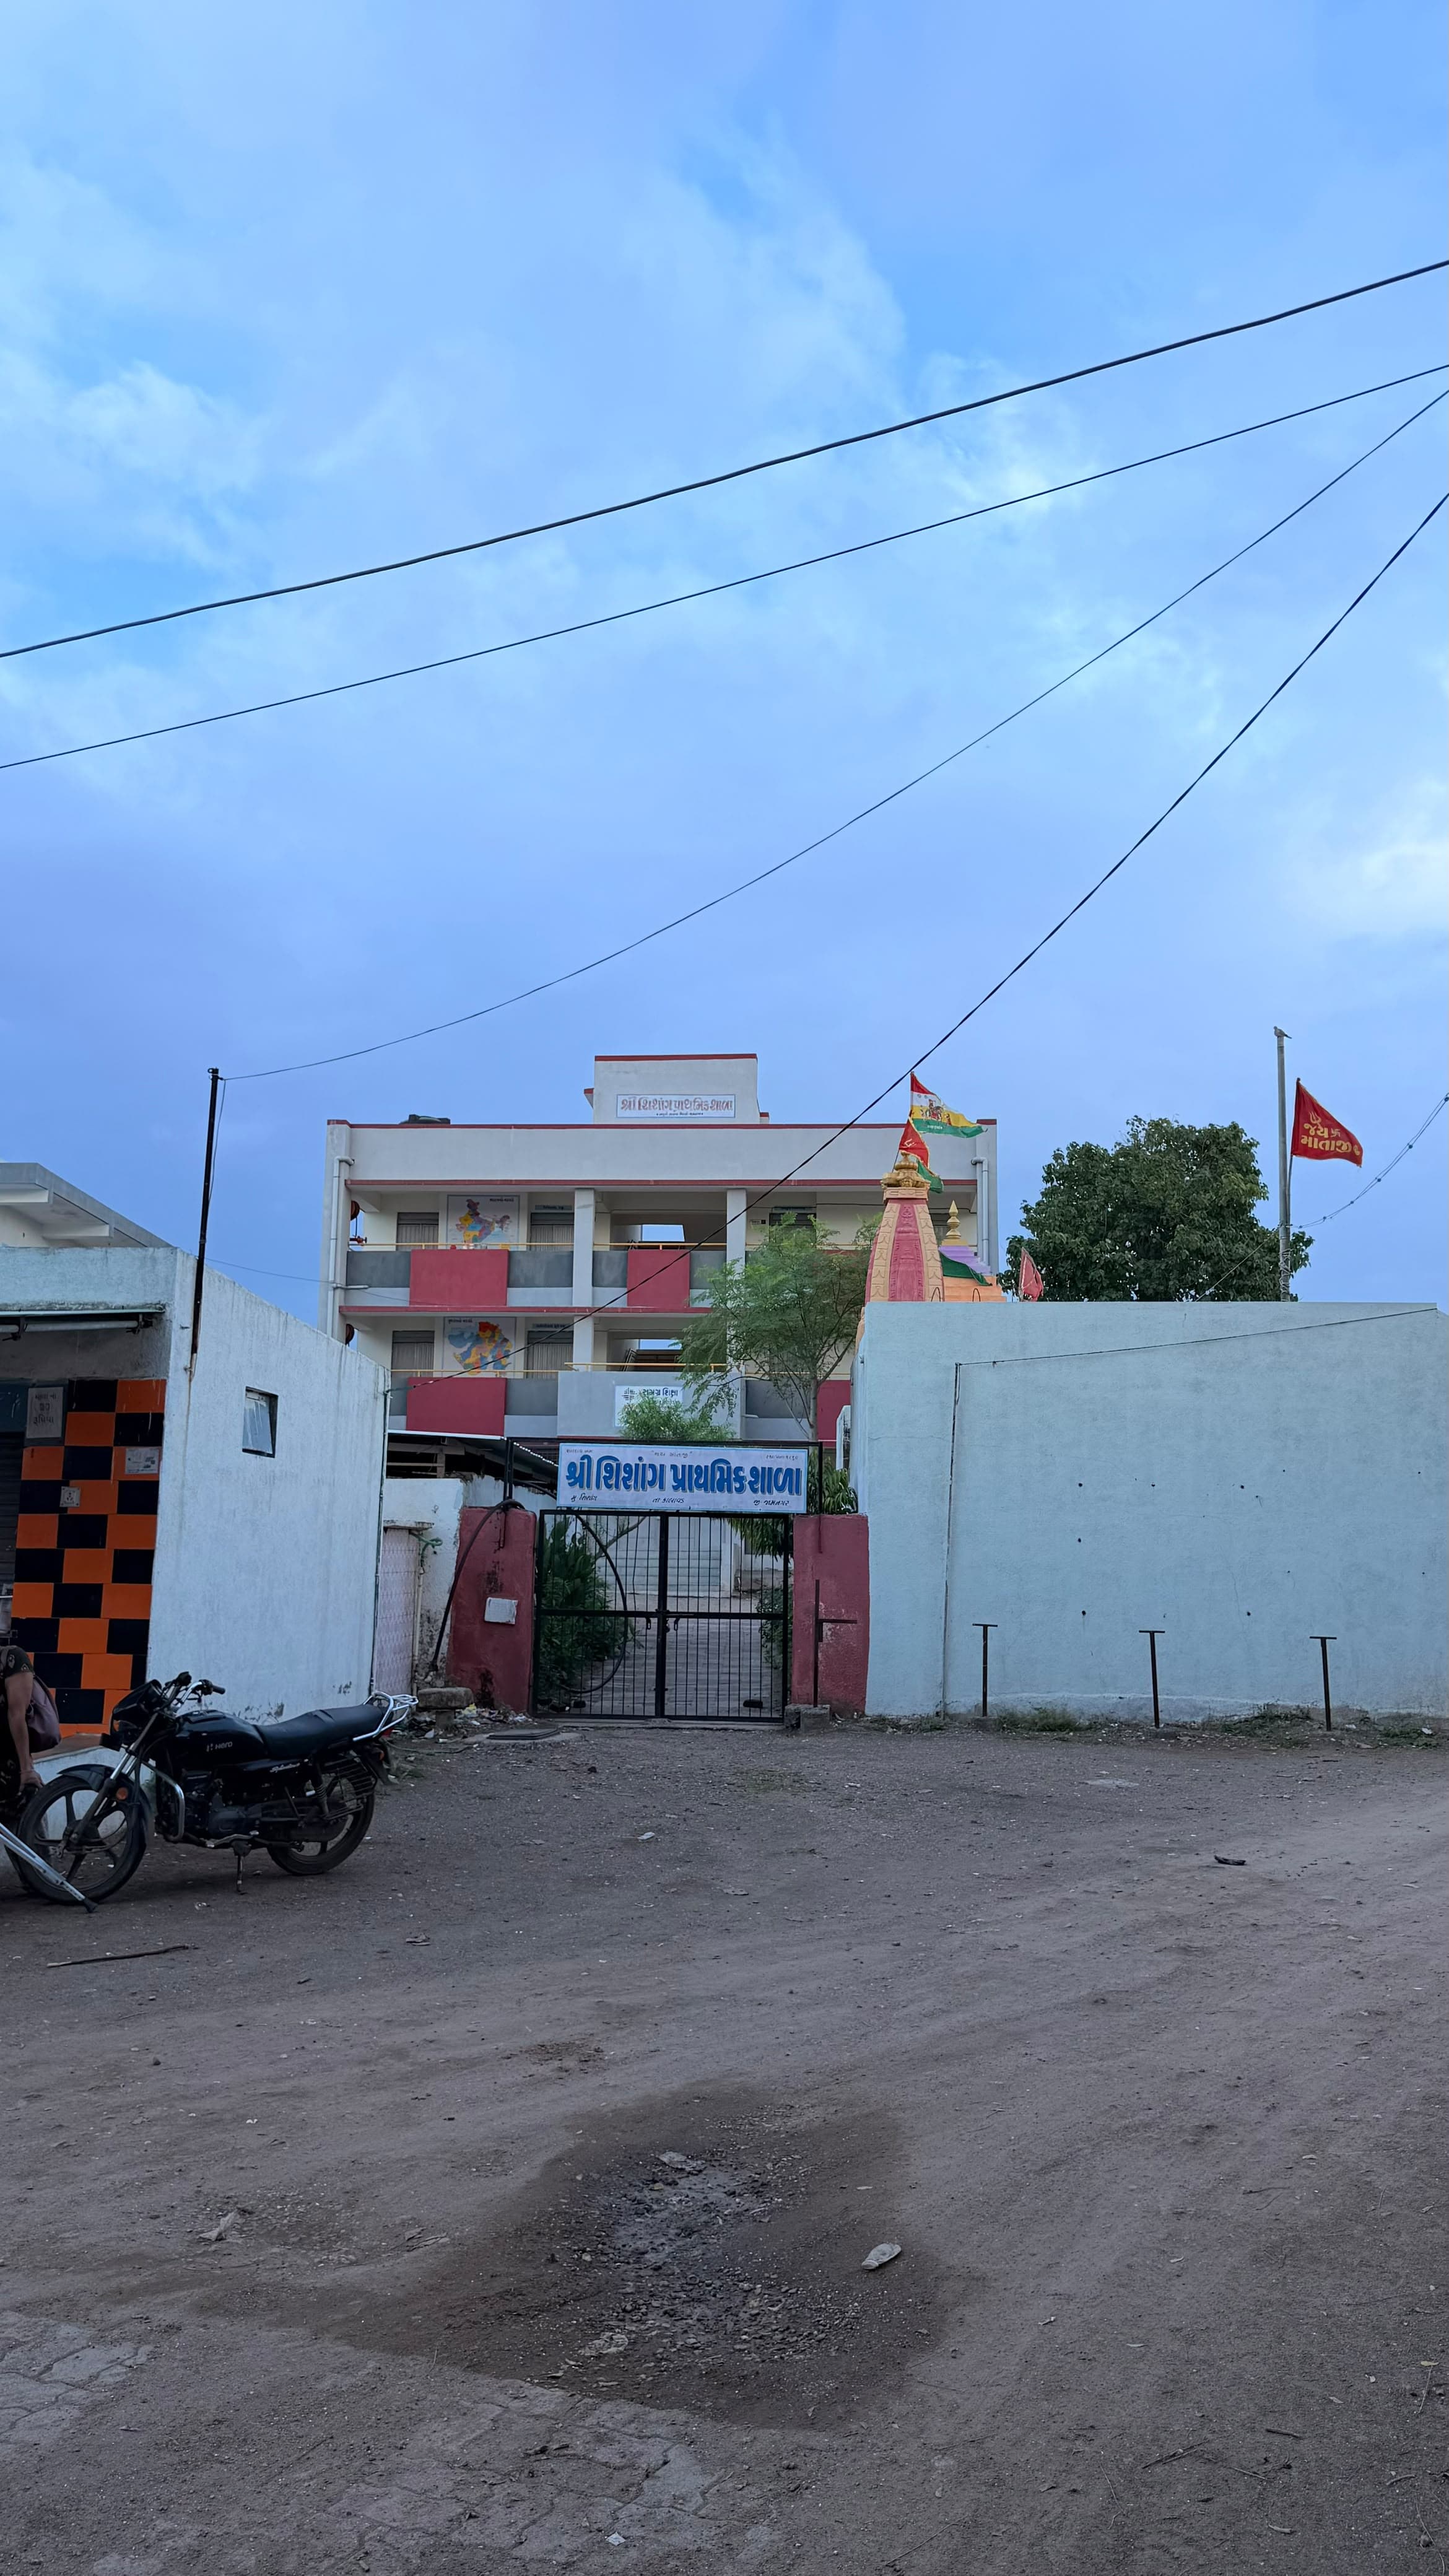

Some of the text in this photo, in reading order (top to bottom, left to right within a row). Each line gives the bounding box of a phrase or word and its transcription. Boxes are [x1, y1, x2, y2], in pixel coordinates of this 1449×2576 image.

[621, 1096, 636, 1111] શ્રી
[1303, 1123, 1329, 1138] જય
[1301, 1135, 1352, 1152] માતાજી
[662, 1387, 678, 1398] શિક્ષા
[565, 1454, 803, 1496] શ્રી શિશાંગ પ્રાથમિક શાળા
